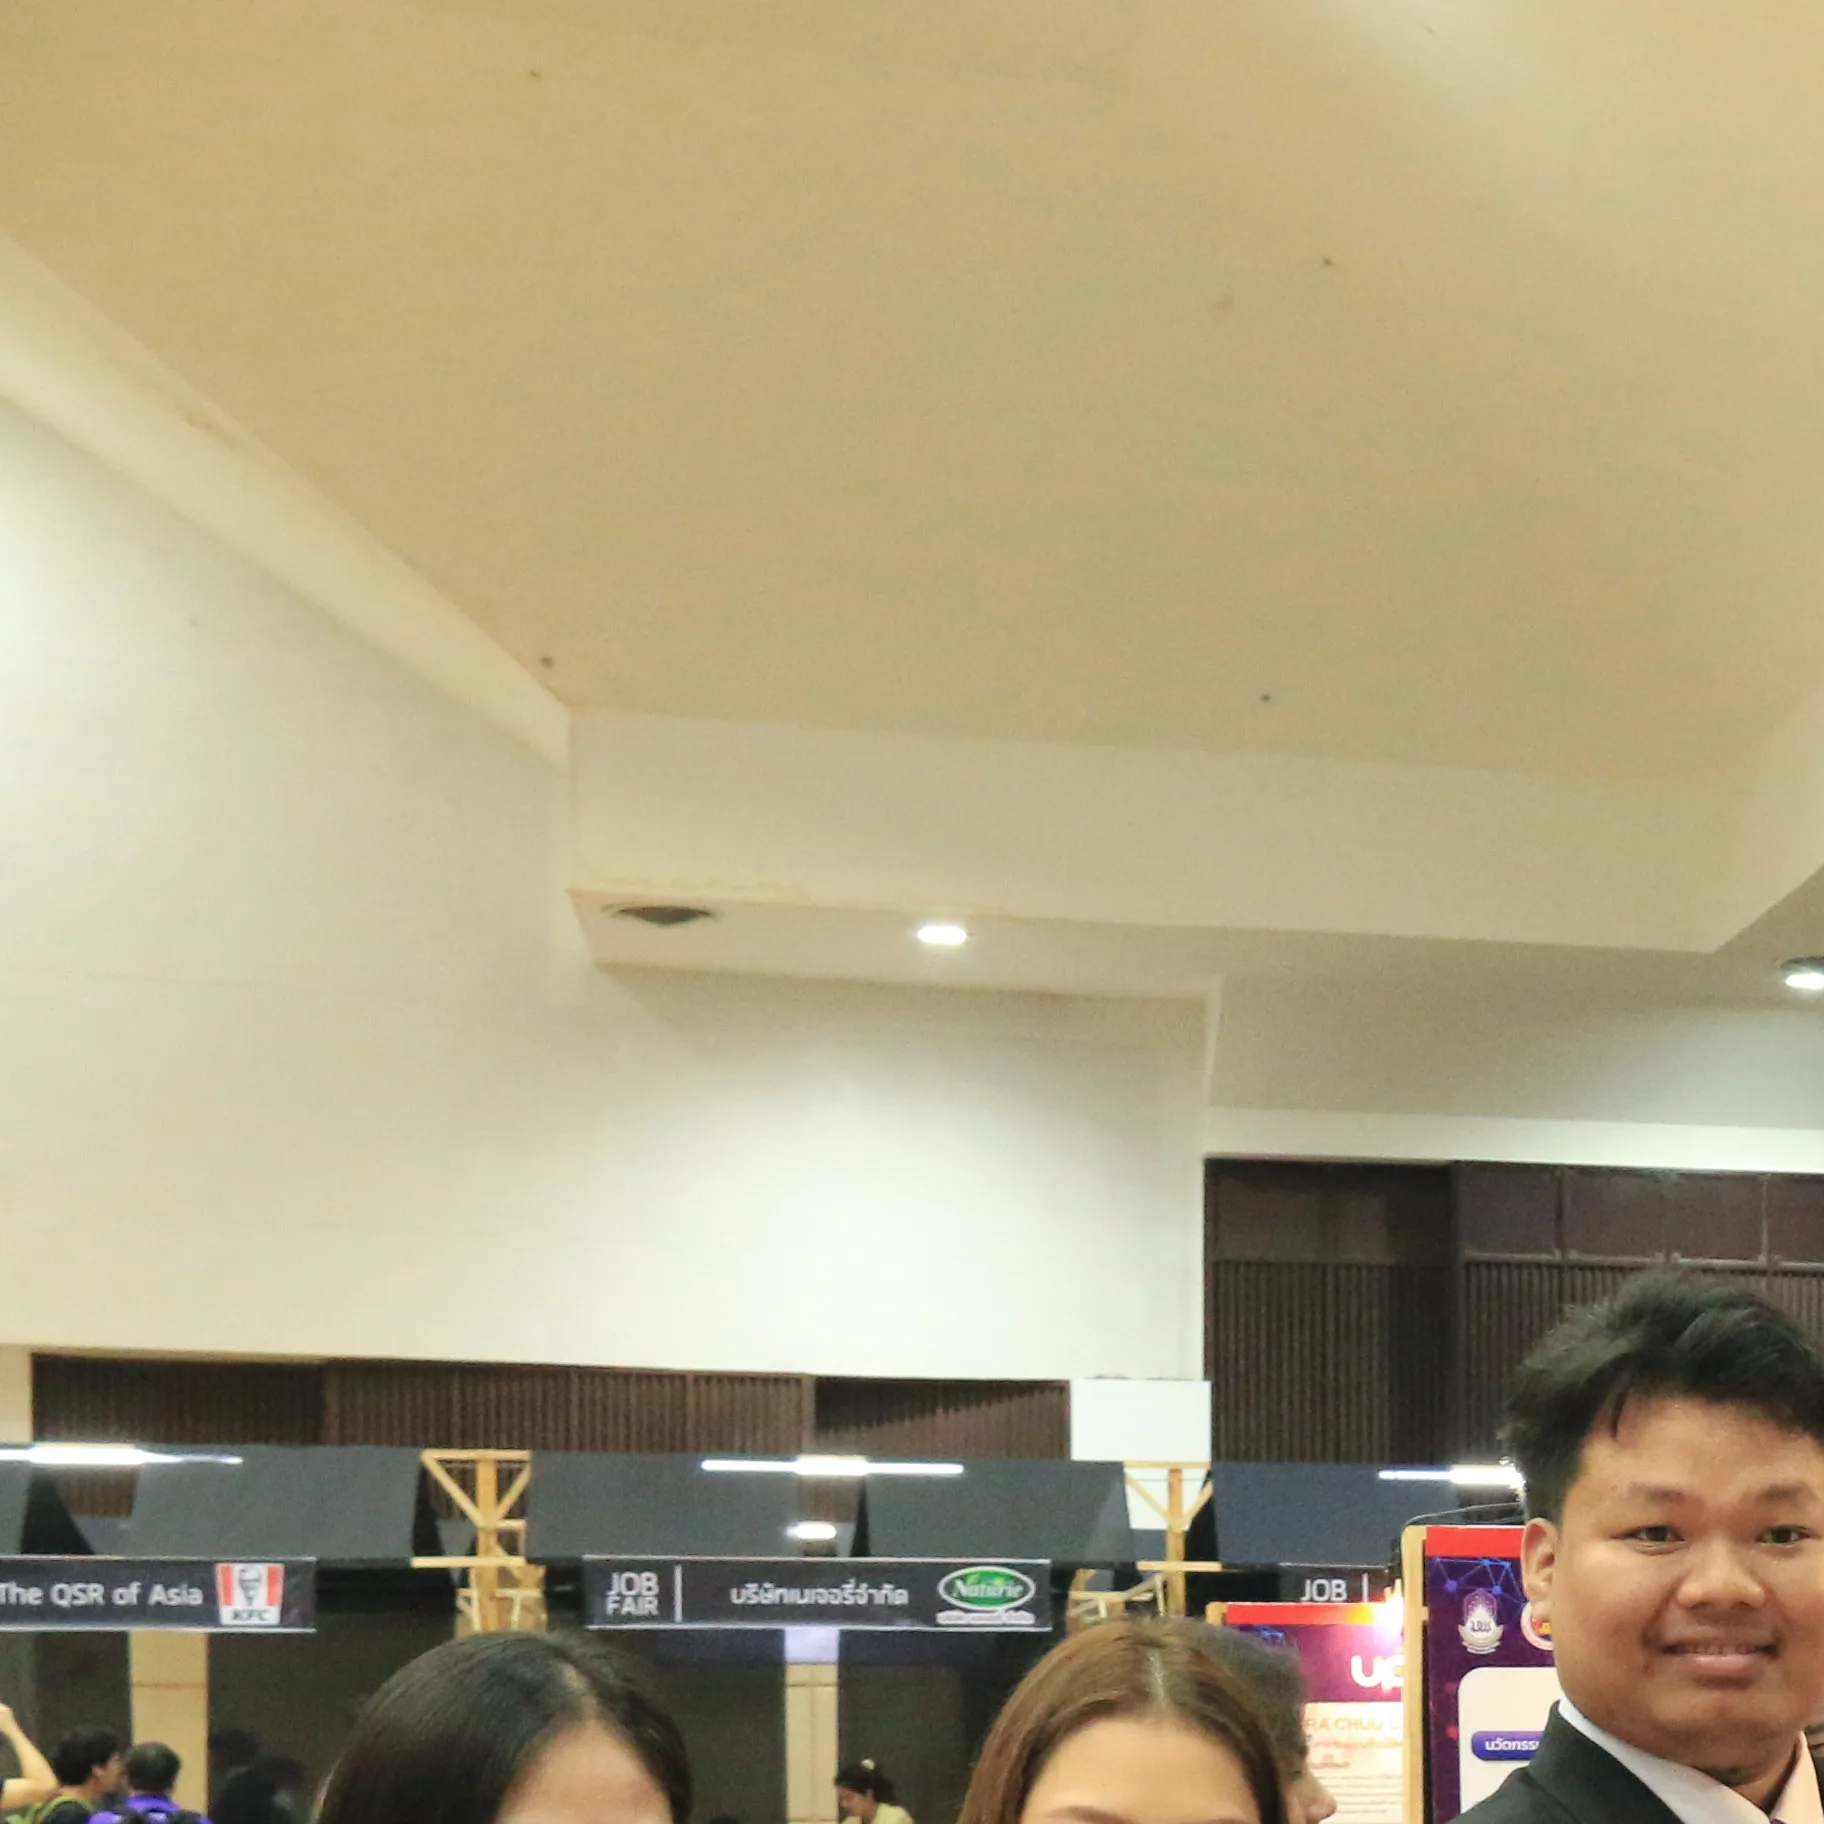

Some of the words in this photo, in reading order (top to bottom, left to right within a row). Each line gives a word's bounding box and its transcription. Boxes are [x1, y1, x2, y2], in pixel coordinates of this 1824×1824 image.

[0, 1581, 44, 1606] The
[50, 1582, 105, 1606] QSR
[111, 1580, 141, 1606] of
[147, 1582, 204, 1606] Asia
[606, 1572, 659, 1595] JOB
[1300, 1579, 1348, 1601] JOB
[605, 1597, 659, 1616] FAIR
